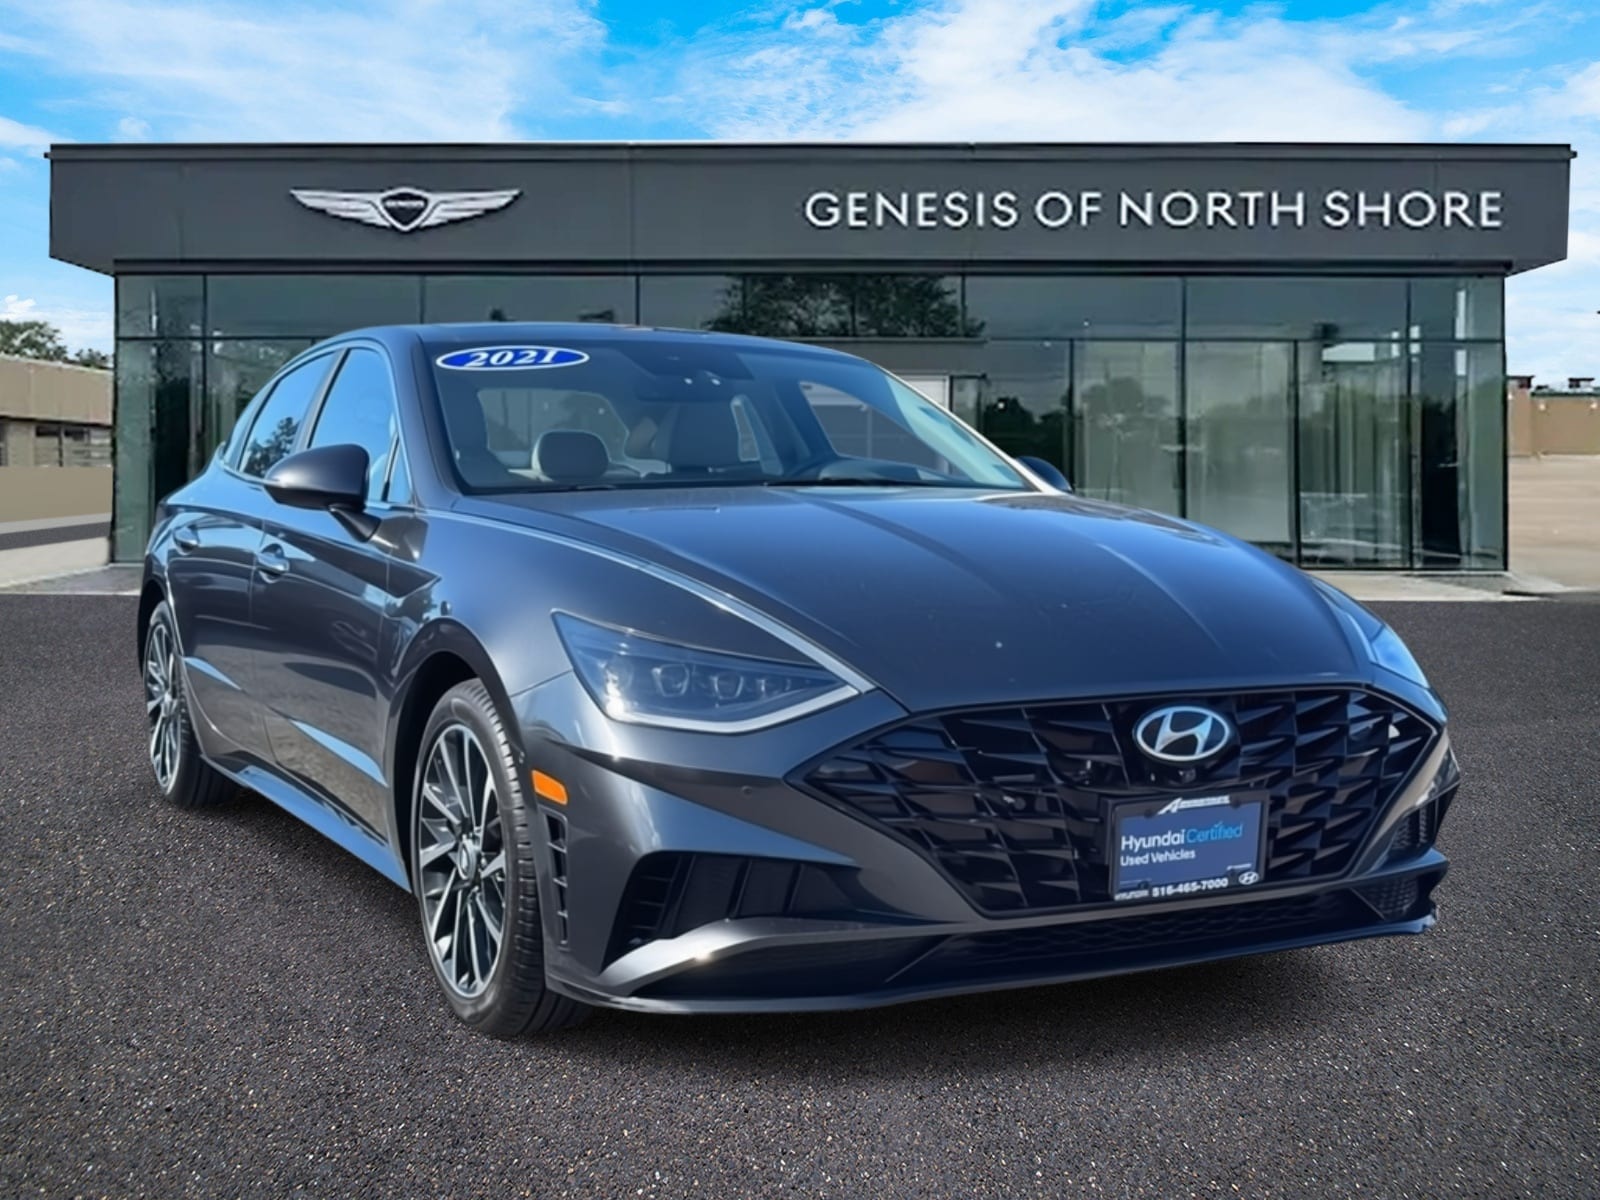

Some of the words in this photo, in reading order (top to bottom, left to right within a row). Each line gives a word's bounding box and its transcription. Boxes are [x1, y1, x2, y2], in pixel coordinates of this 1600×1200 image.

[805, 191, 1019, 227] GENESIS
[1034, 191, 1101, 227] OF
[1120, 190, 1304, 227] NORTH
[1323, 190, 1502, 227] SHORE
[464, 350, 558, 367] 2021
[1121, 829, 1185, 852] Hyundai
[1186, 821, 1243, 844] Certified
[1120, 853, 1149, 867] Used
[1151, 849, 1196, 863] Vehicles
